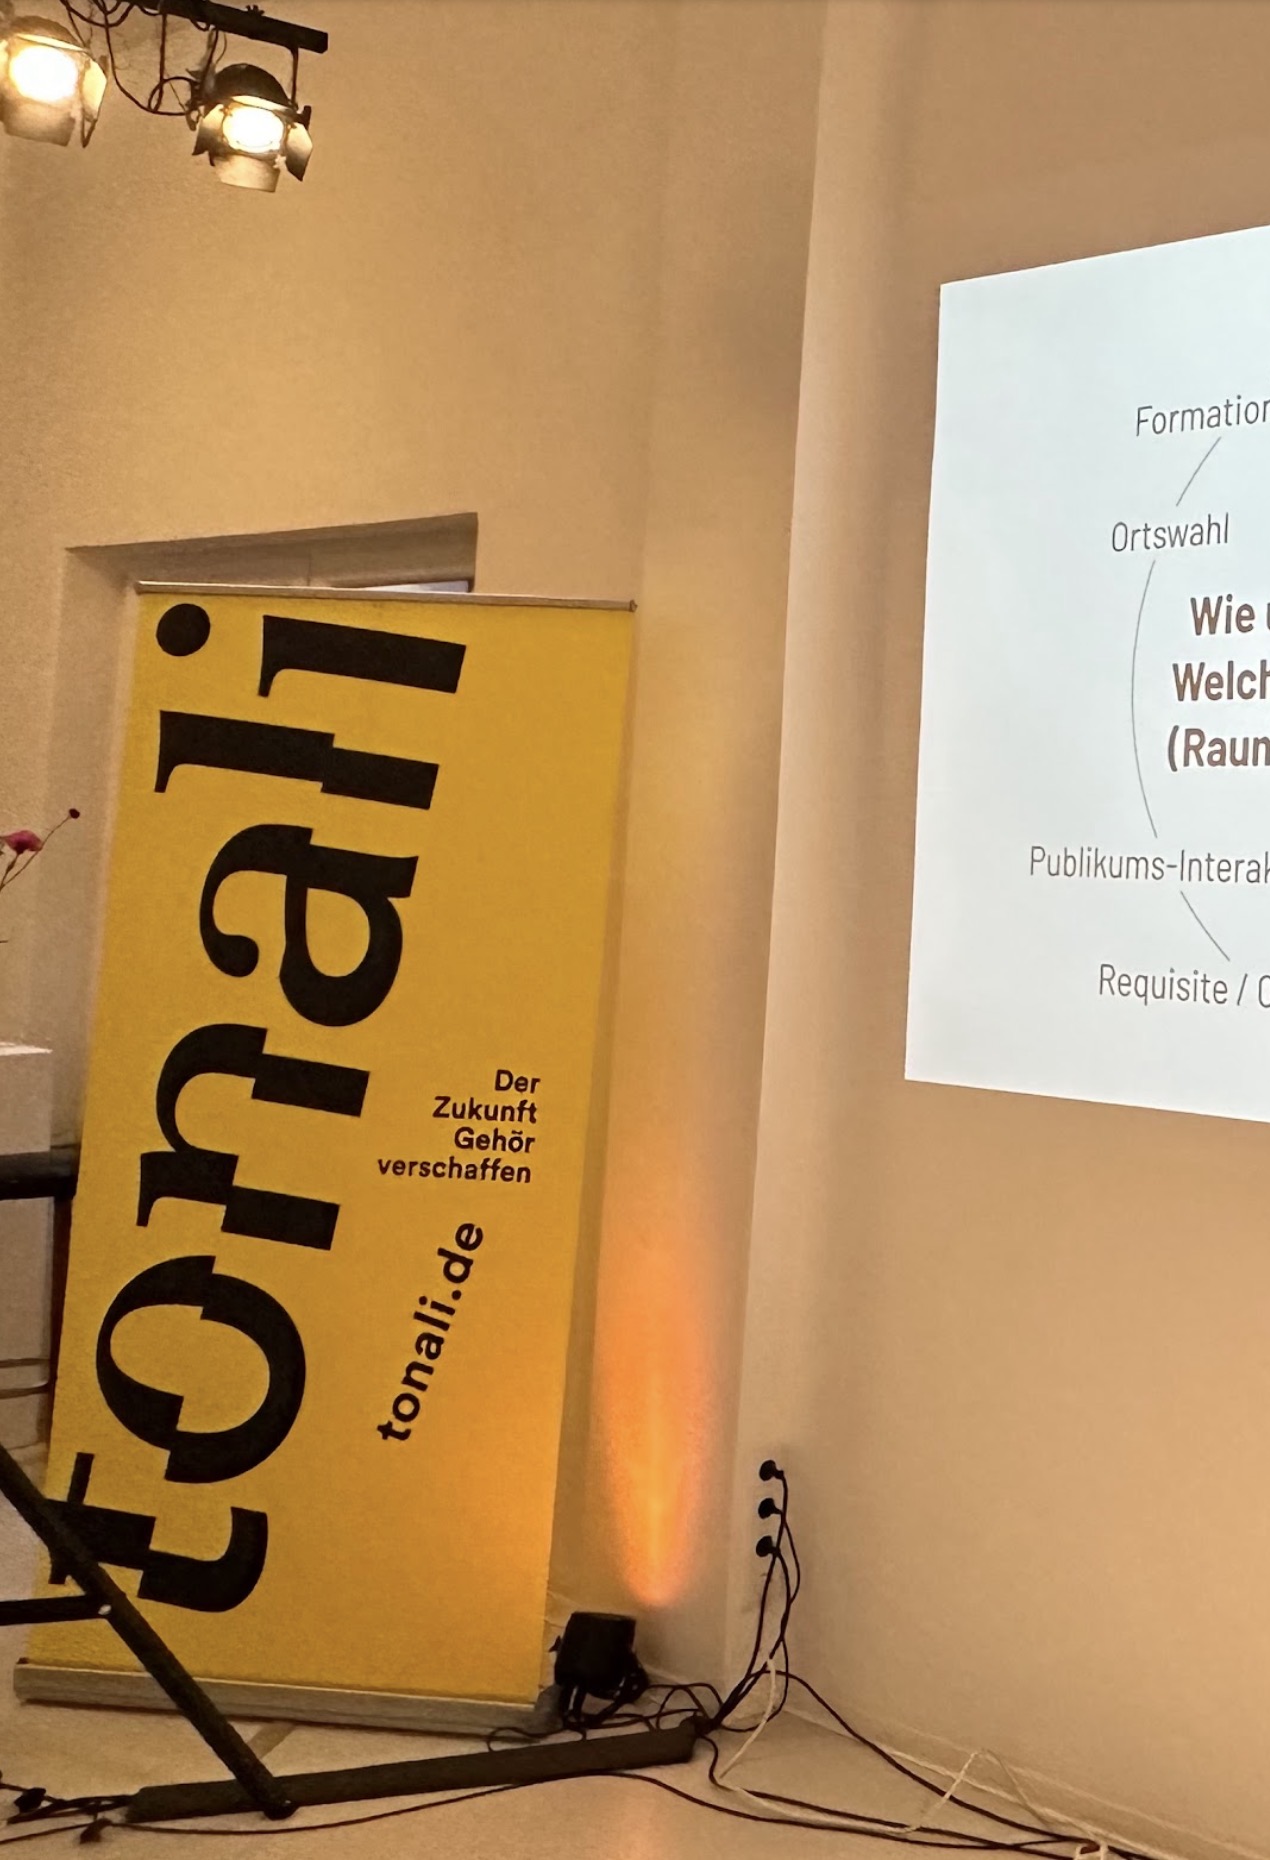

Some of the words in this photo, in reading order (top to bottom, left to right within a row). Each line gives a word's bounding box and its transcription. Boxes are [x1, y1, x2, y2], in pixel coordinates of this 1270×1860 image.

[1111, 512, 1230, 553] Ortswahl
[1190, 593, 1256, 636] Wie
[1099, 963, 1229, 1006] Requisite
[1236, 973, 1249, 1006] /
[494, 1068, 541, 1094] Der
[49, 602, 467, 1614] tonali
[432, 1096, 538, 1124] Zukunft
[453, 1126, 536, 1154] Gehör
[377, 1155, 532, 1184] verschaffen
[376, 1222, 484, 1441] tonali.de
